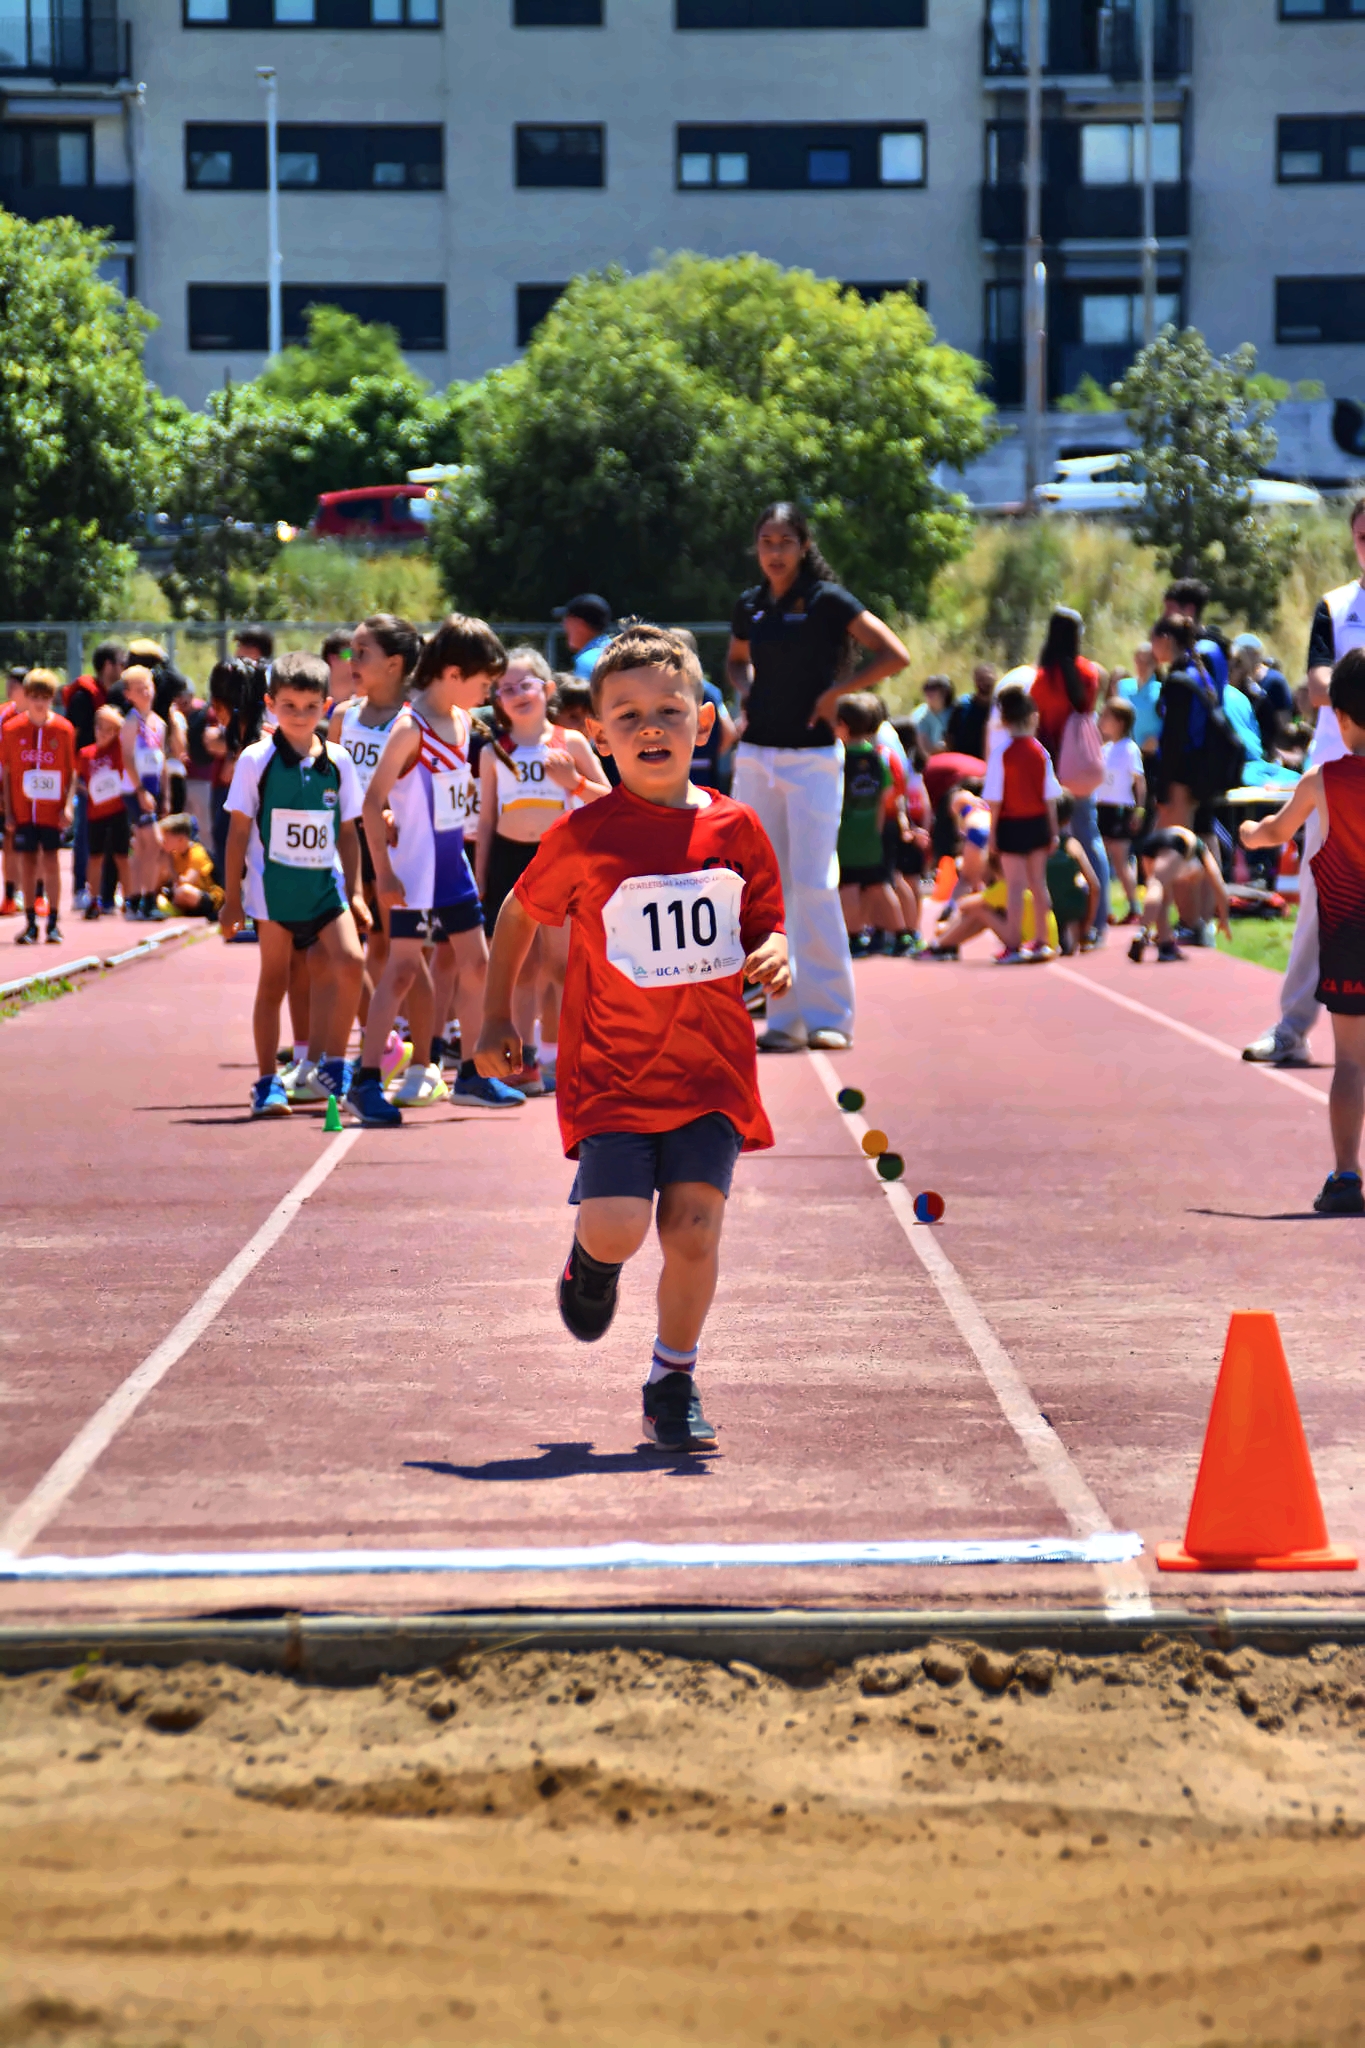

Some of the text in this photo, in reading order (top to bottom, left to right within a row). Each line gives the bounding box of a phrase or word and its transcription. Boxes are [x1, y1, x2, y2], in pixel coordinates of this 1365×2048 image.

[286, 824, 328, 850] 508
[642, 897, 717, 951] 110
[656, 966, 680, 977] UCA
